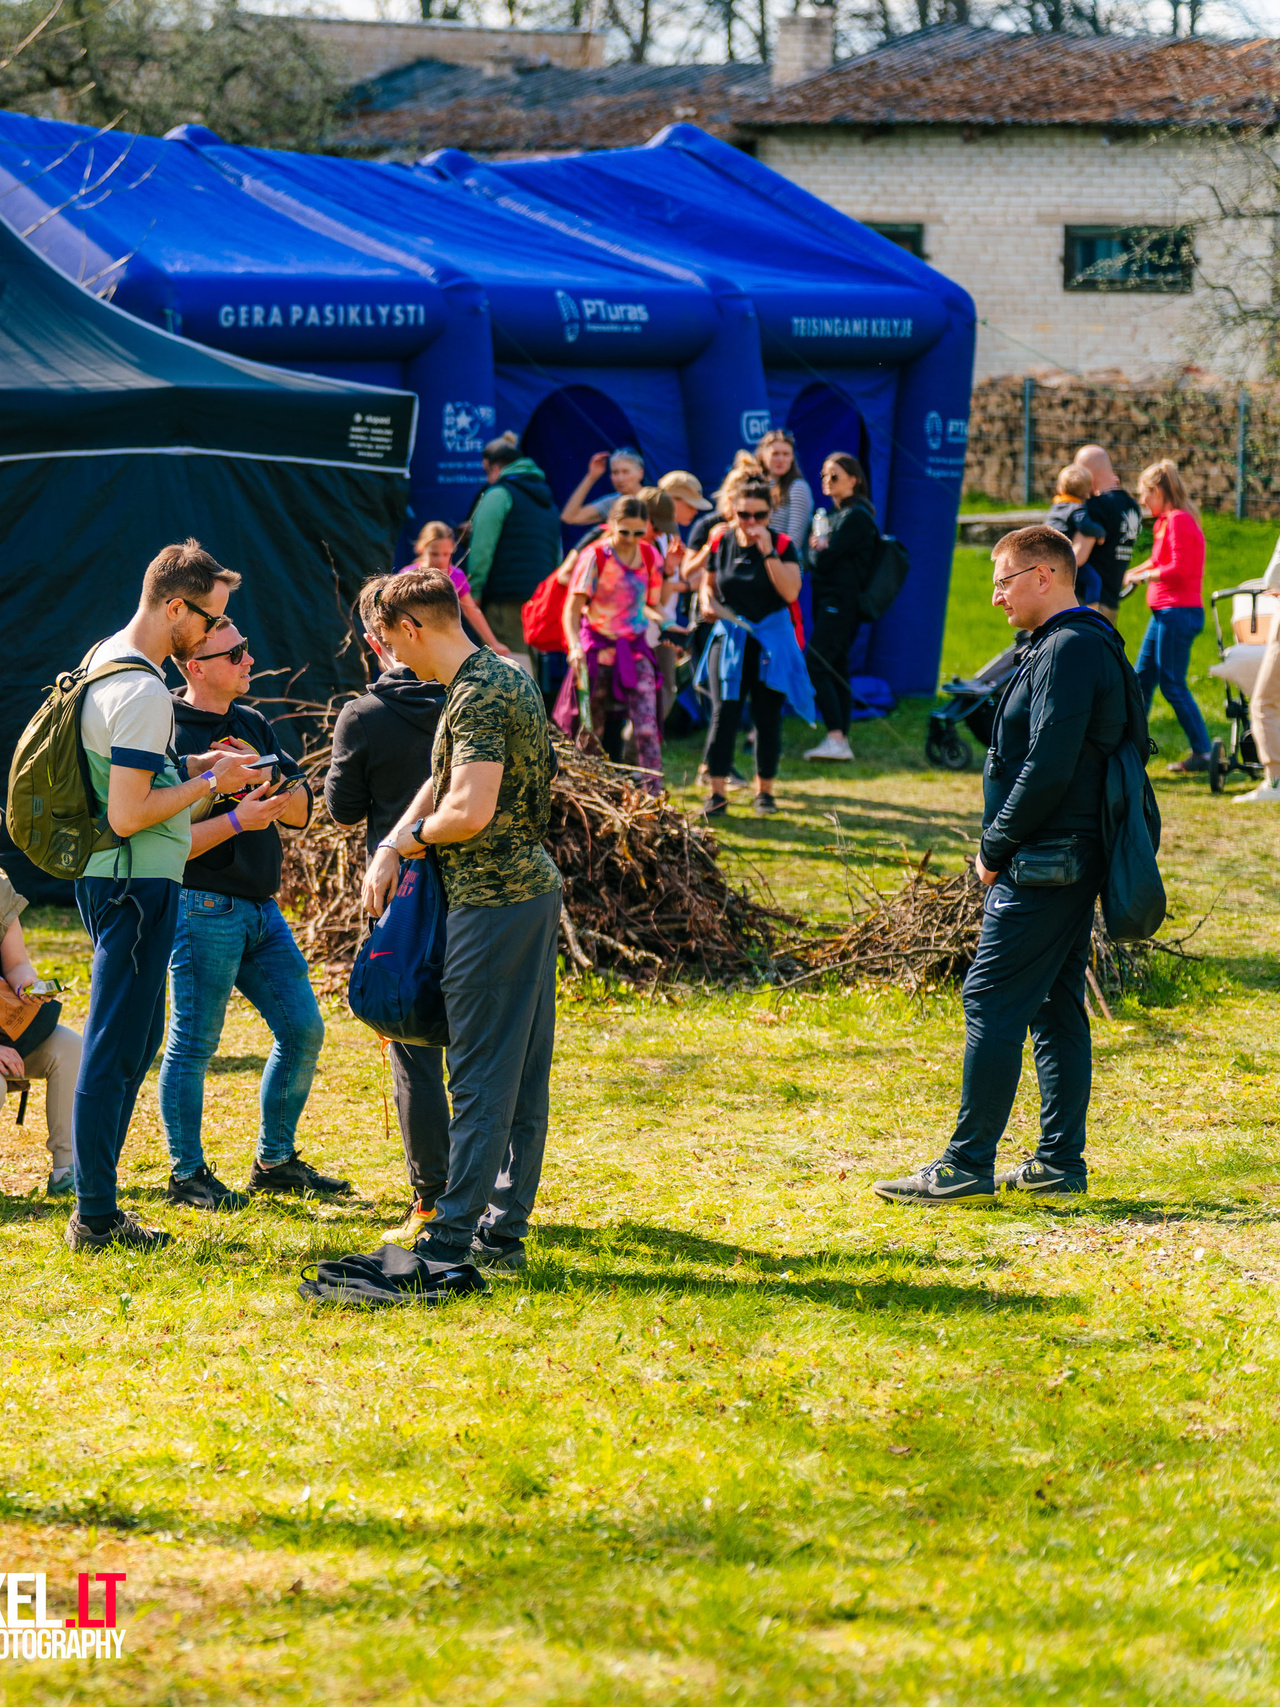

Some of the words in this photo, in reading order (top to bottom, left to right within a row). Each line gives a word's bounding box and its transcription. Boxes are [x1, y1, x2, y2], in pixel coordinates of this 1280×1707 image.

[220, 304, 283, 328] GERA
[290, 304, 425, 327] PASIKLYSTI
[582, 299, 649, 322] PTuras
[871, 317, 913, 338] KELYJE
